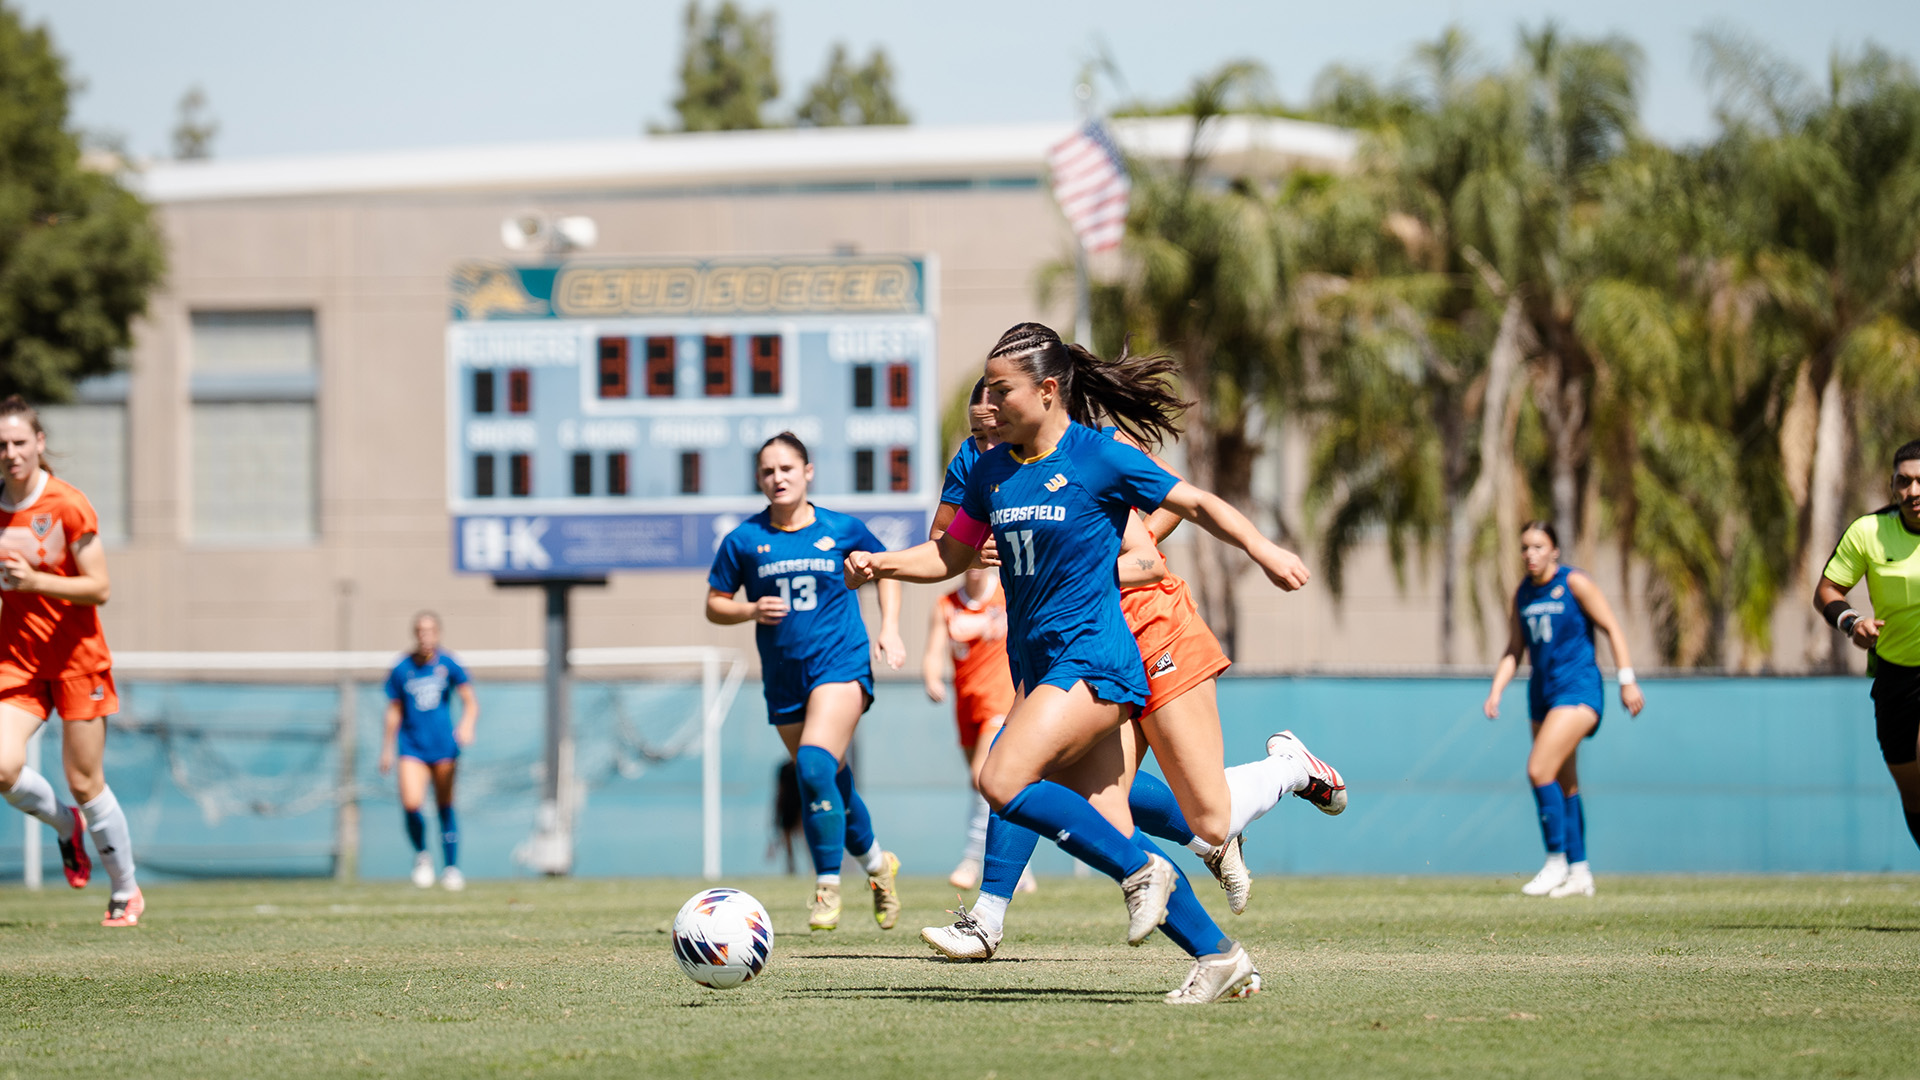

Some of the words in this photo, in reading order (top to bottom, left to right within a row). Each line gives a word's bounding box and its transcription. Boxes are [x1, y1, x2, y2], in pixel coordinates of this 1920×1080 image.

[560, 268, 696, 313] CSUB
[702, 265, 912, 311] SOCCER
[599, 334, 781, 397] 32:34
[1004, 529, 1036, 576] 11
[775, 575, 818, 612] 13
